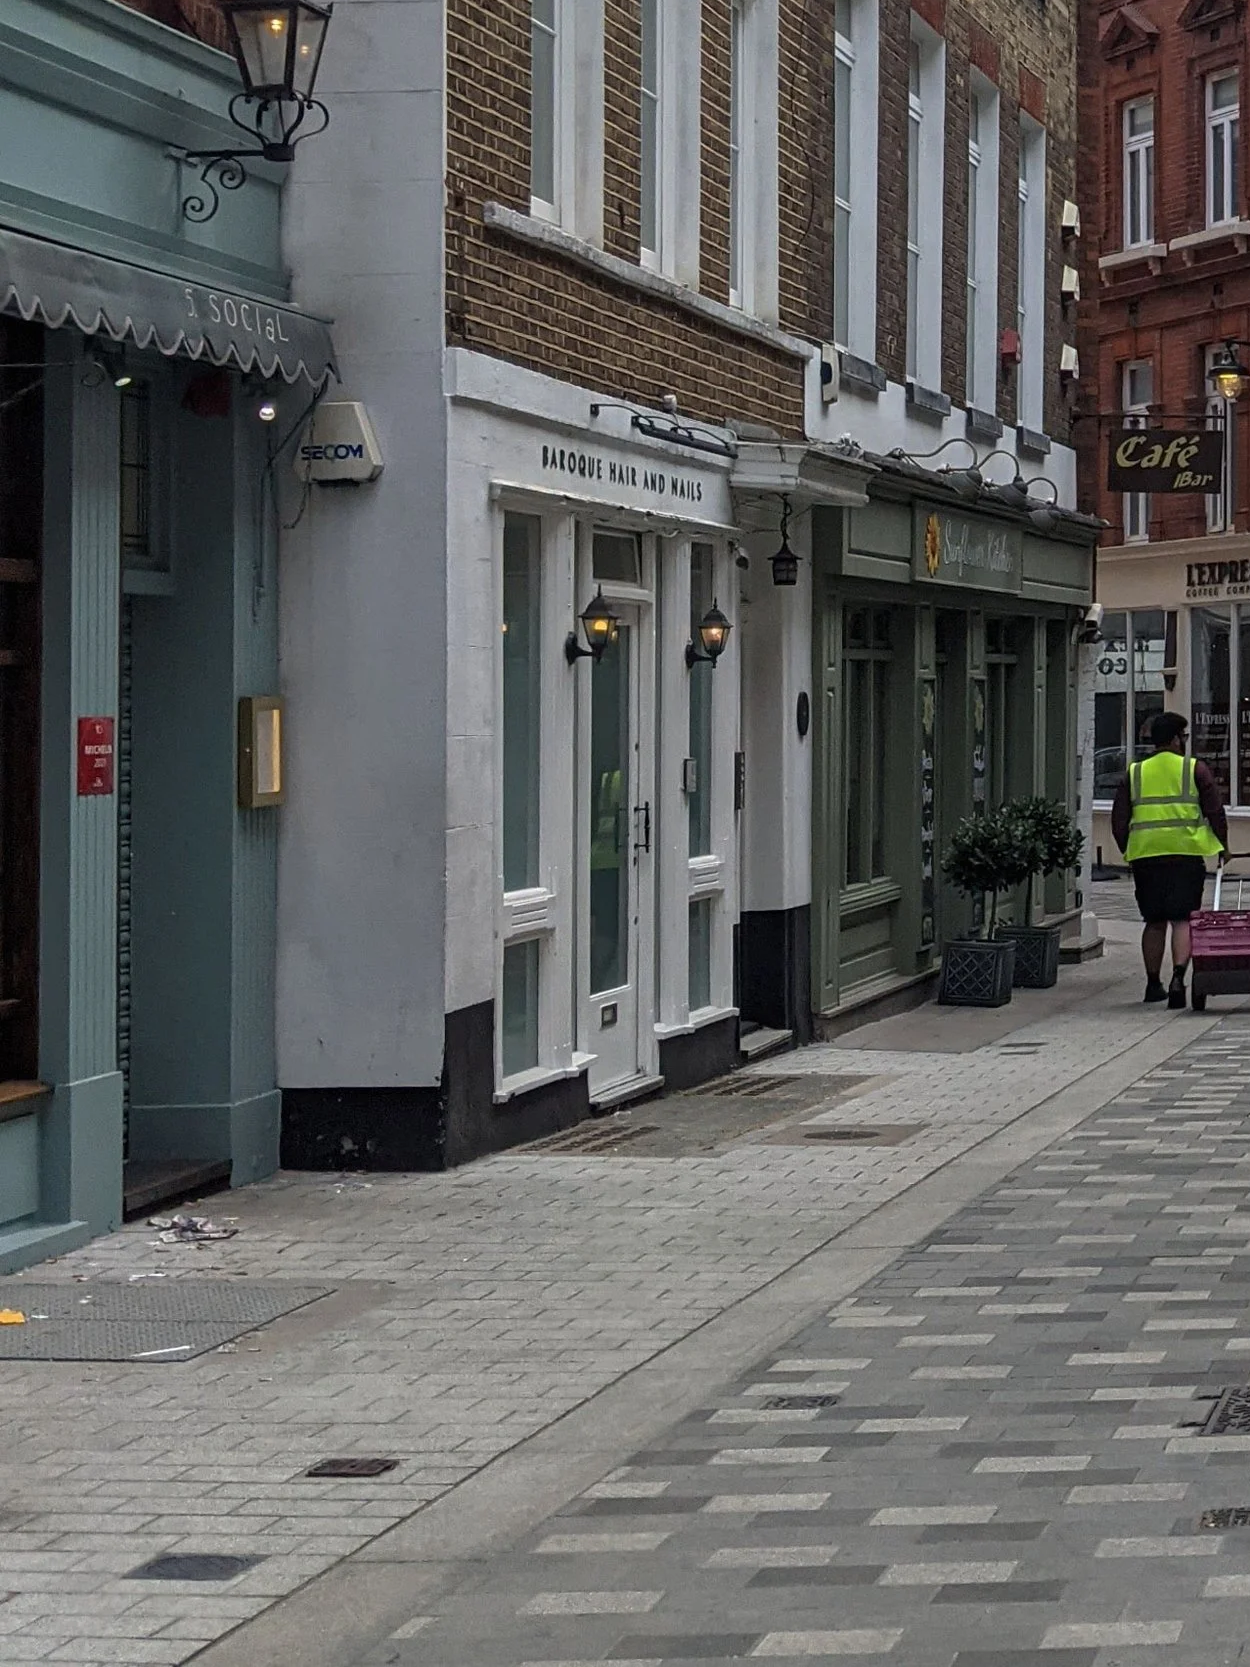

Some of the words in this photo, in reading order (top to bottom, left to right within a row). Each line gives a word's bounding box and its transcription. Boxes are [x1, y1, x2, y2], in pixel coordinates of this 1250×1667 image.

[300, 444, 364, 461] SECOM
[1115, 435, 1200, 469] Café
[541, 445, 602, 480] BAROQUE
[609, 461, 637, 487] HAIR
[643, 470, 666, 495] AND
[671, 476, 703, 502] NAILS
[1173, 471, 1213, 489] Bar
[1185, 586, 1219, 598] COFFEE
